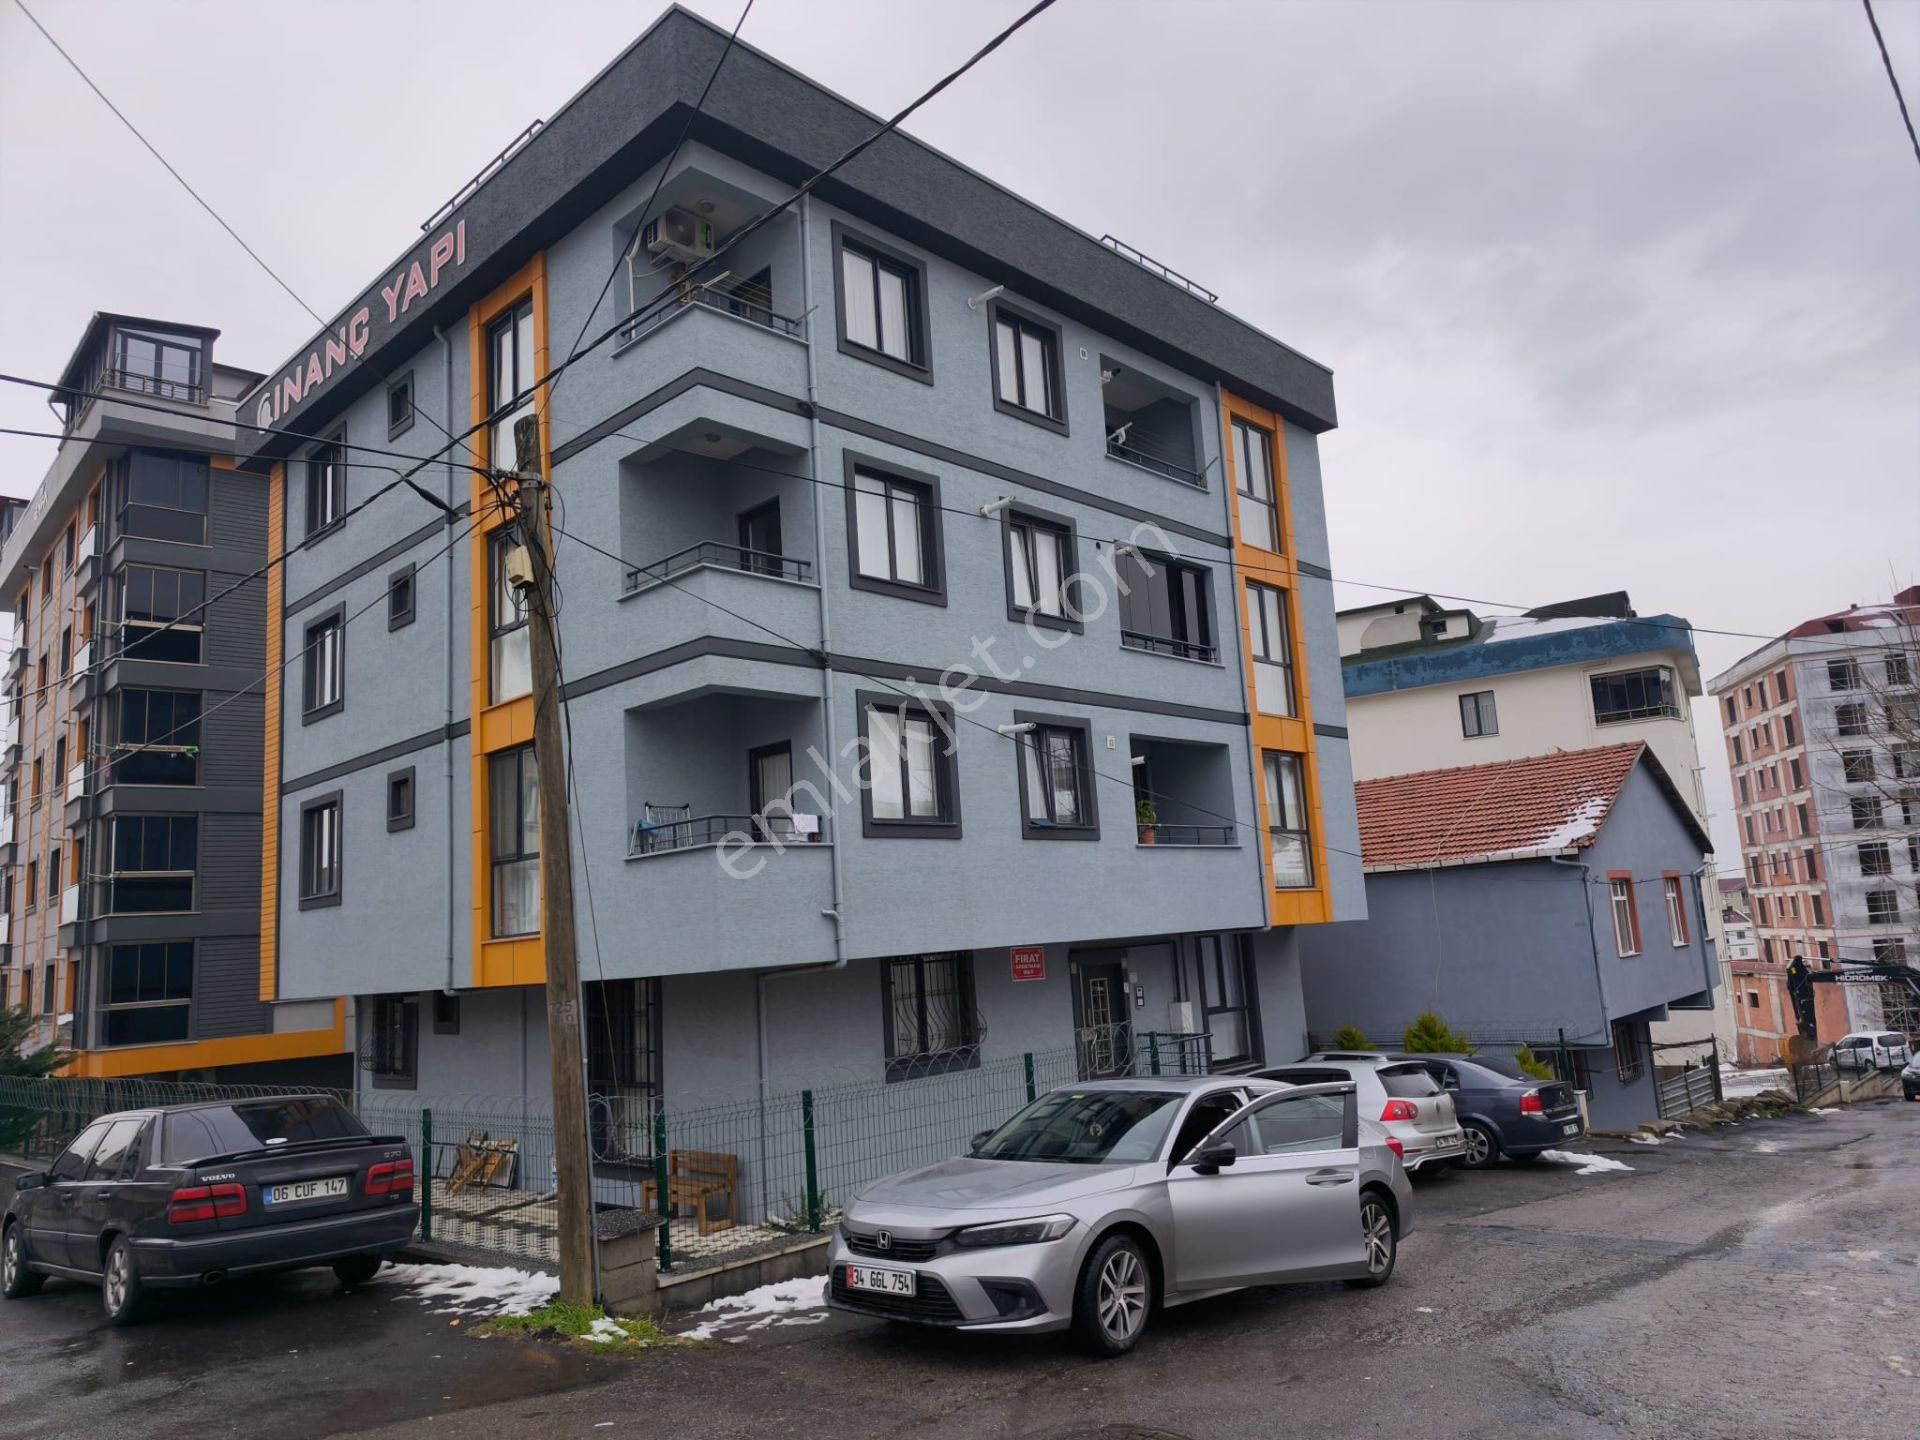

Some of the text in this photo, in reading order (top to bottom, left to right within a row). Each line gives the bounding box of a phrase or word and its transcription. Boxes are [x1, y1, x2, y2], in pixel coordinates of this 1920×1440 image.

[381, 219, 466, 323] YAPI
[1015, 953, 1040, 963] FIRAT
[201, 1173, 235, 1182] VOLVO
[273, 1179, 345, 1201] 06 CUF 147
[853, 1268, 910, 1292] 34 GGL 754
